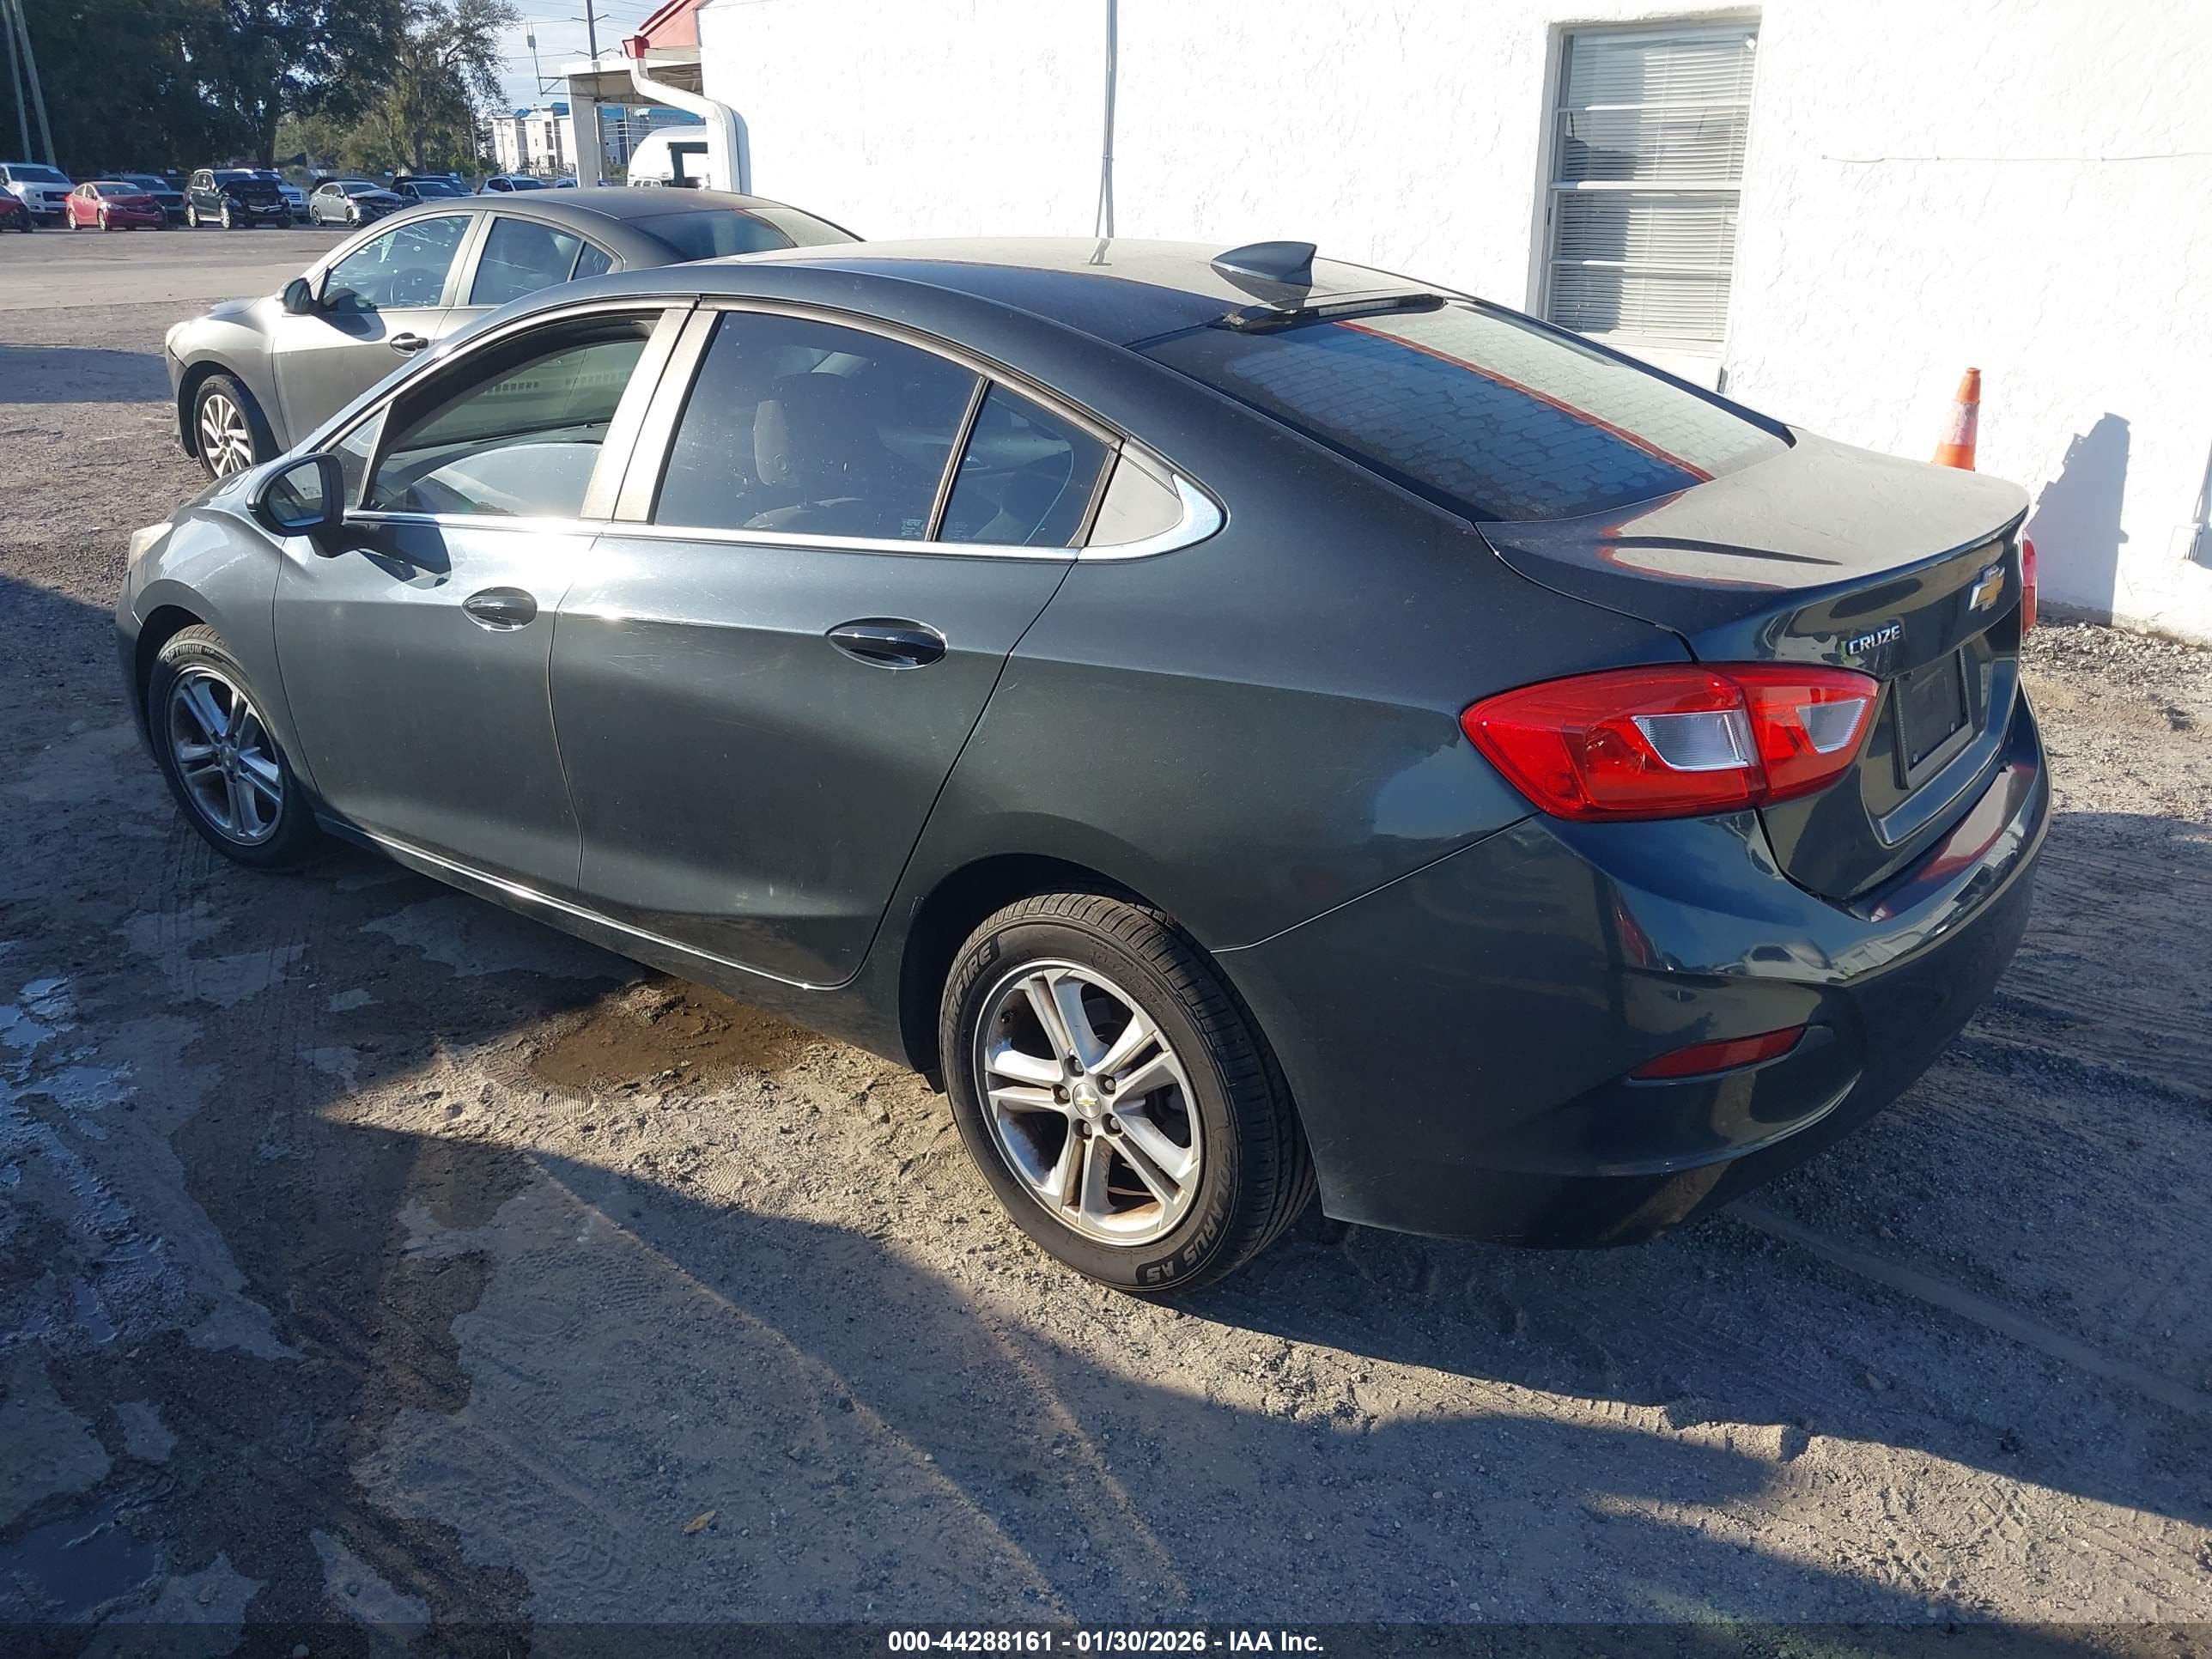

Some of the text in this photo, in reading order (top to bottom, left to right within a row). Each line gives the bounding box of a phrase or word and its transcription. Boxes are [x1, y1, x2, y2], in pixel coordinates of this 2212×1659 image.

[1849, 624, 1900, 655] CRUZE
[165, 644, 202, 663] OPTIMUM
[1146, 1261, 1175, 1283] AS
